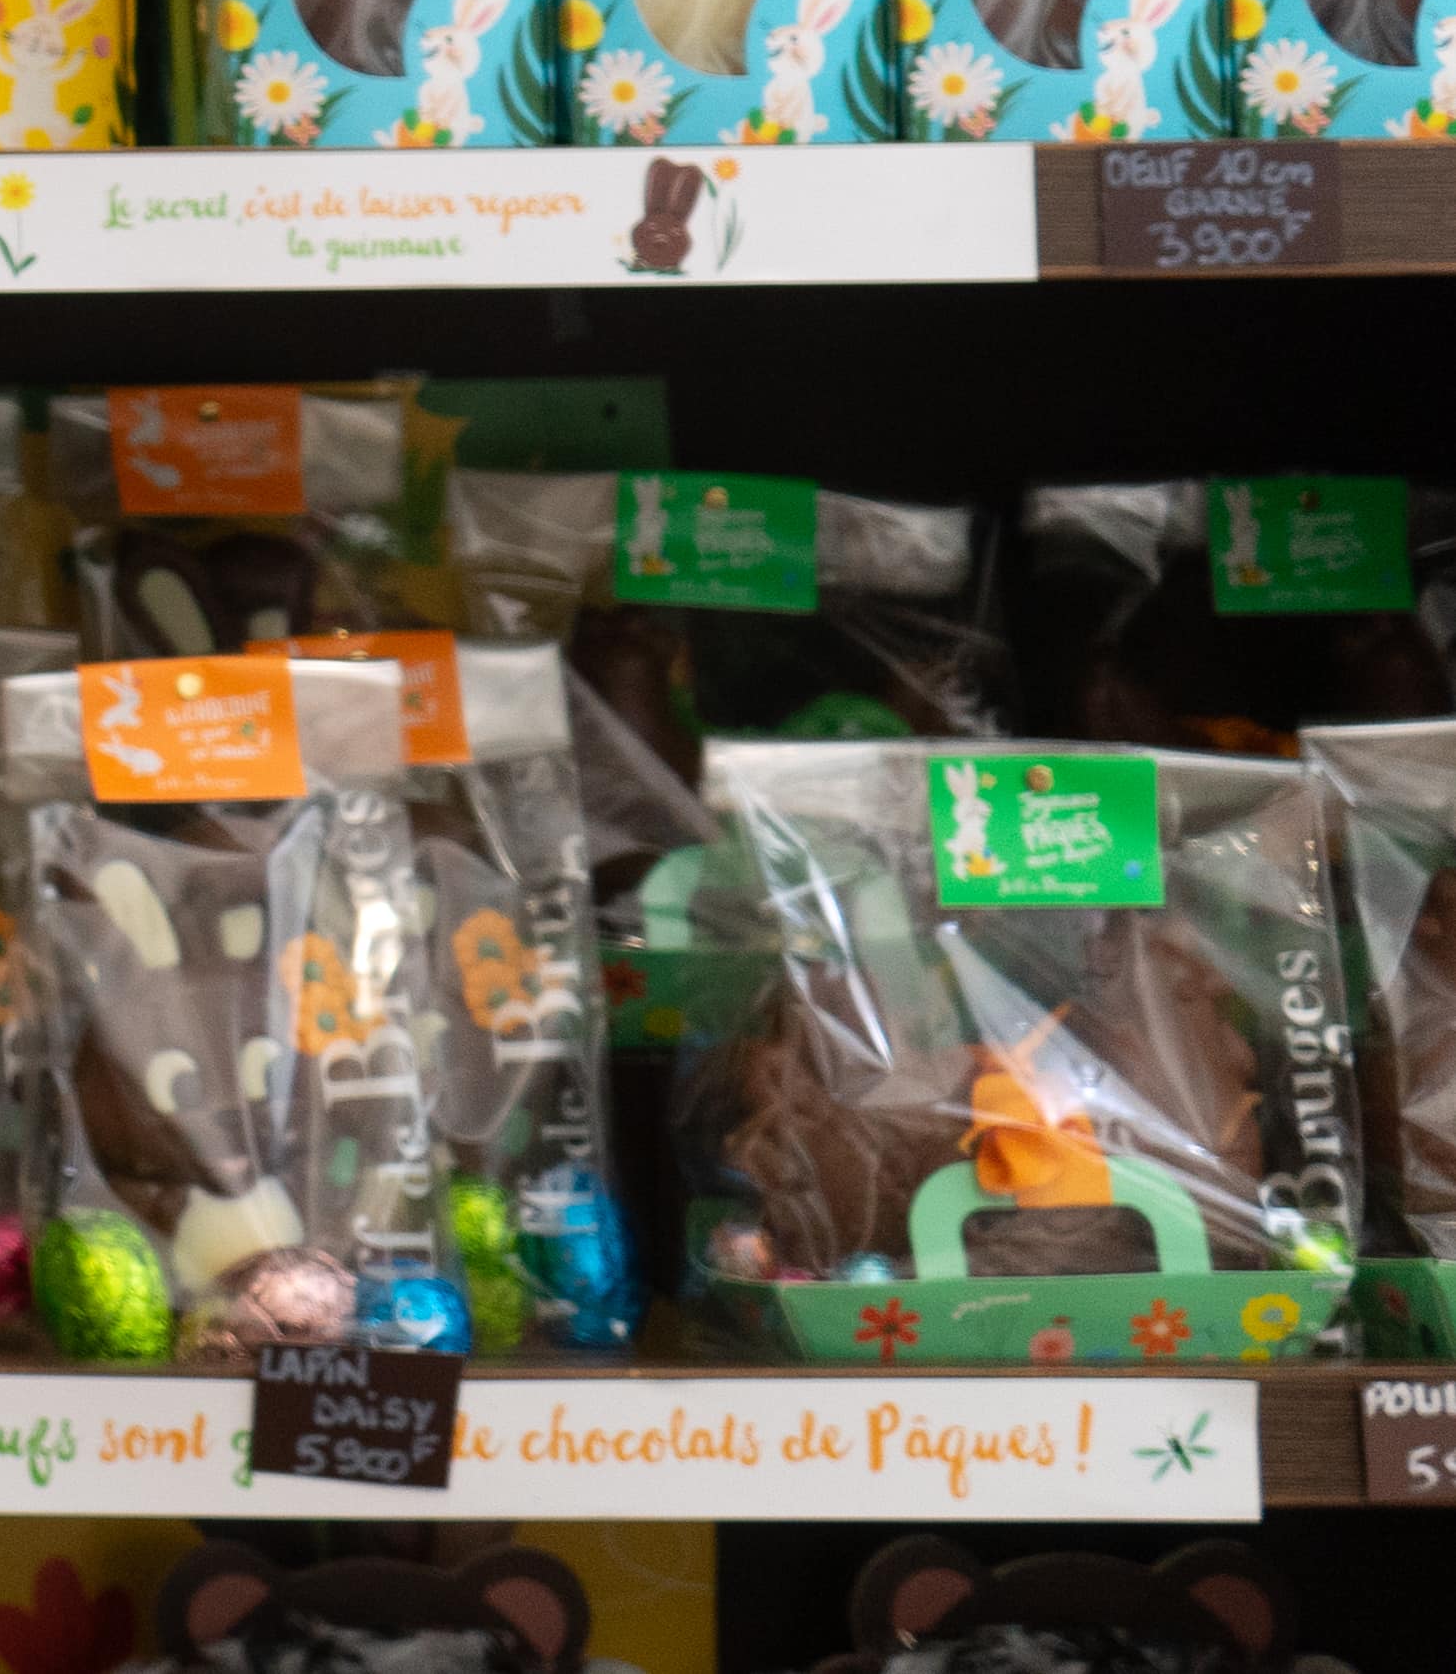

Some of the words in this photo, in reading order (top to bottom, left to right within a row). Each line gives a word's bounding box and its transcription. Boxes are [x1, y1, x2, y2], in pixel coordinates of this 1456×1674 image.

[1105, 148, 1189, 188] OEUF
[100, 1411, 209, 1464] sont
[520, 1402, 763, 1466] chocolats
[782, 1409, 851, 1462] de
[866, 1400, 1057, 1504] Pâques
